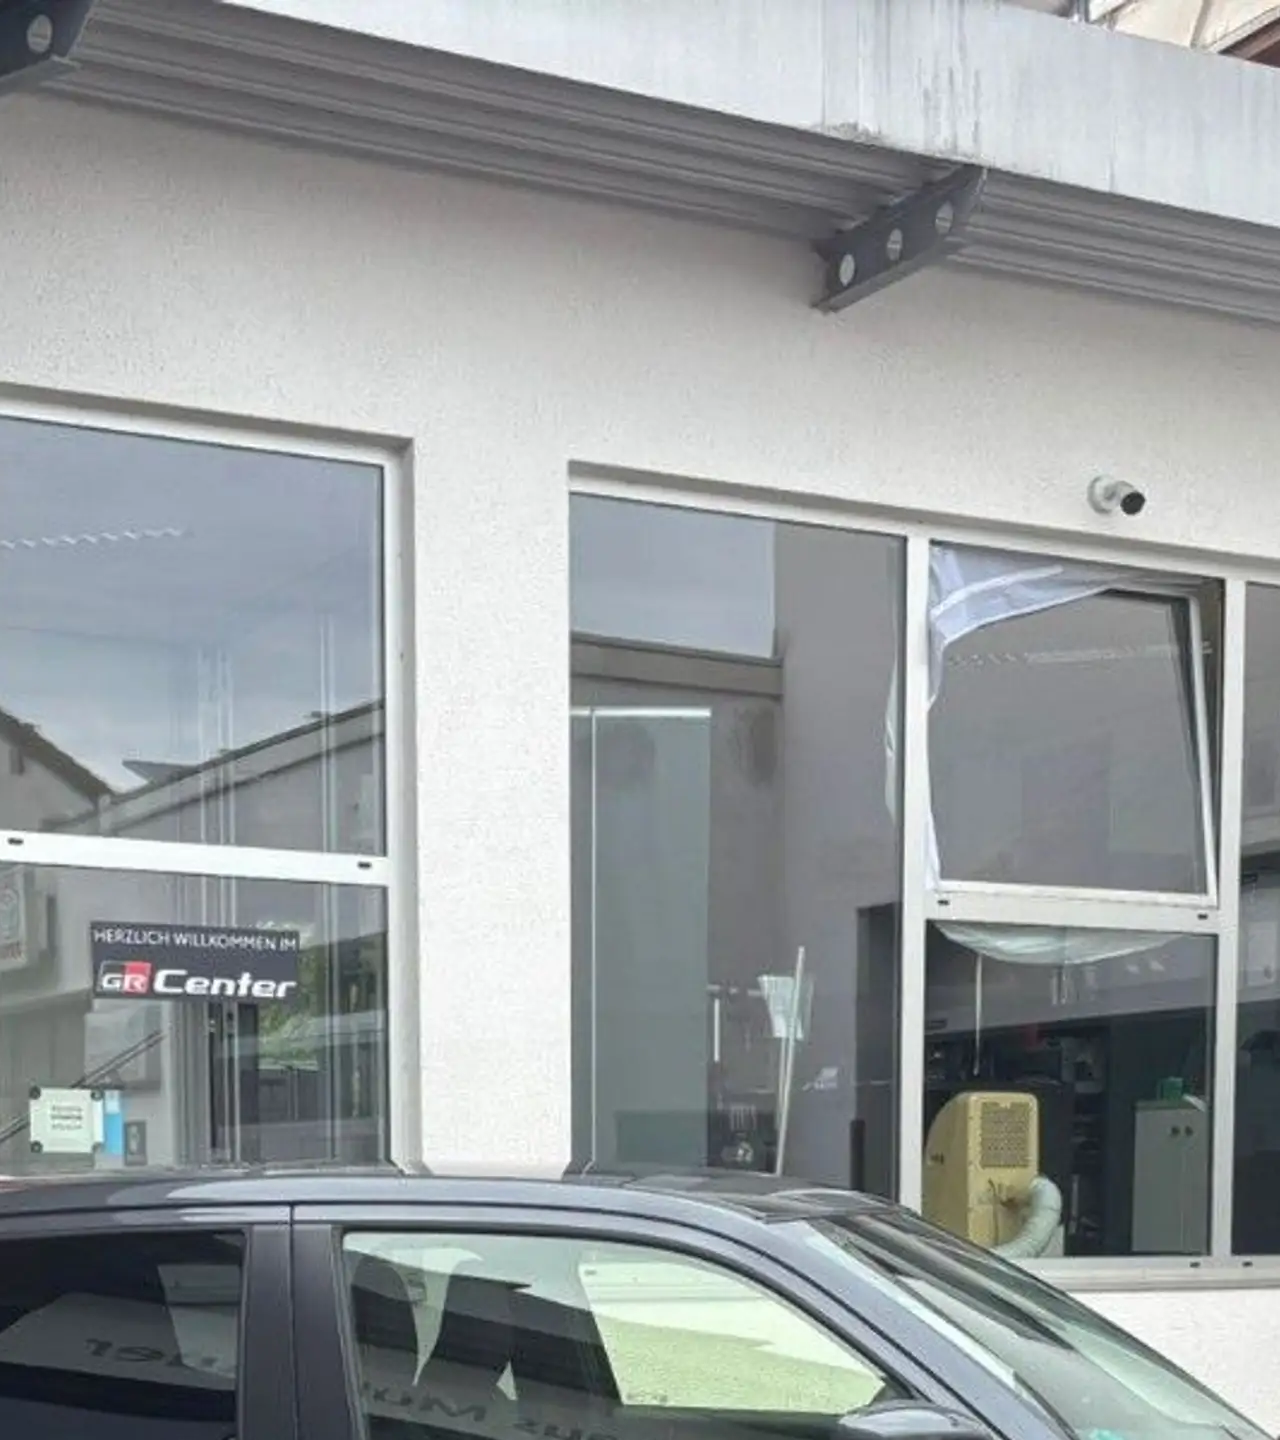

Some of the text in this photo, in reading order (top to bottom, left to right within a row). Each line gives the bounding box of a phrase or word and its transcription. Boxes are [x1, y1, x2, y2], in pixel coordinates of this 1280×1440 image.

[94, 928, 297, 952] HERZLICH WILLKOMMEN IM
[101, 968, 298, 998] GR Center
